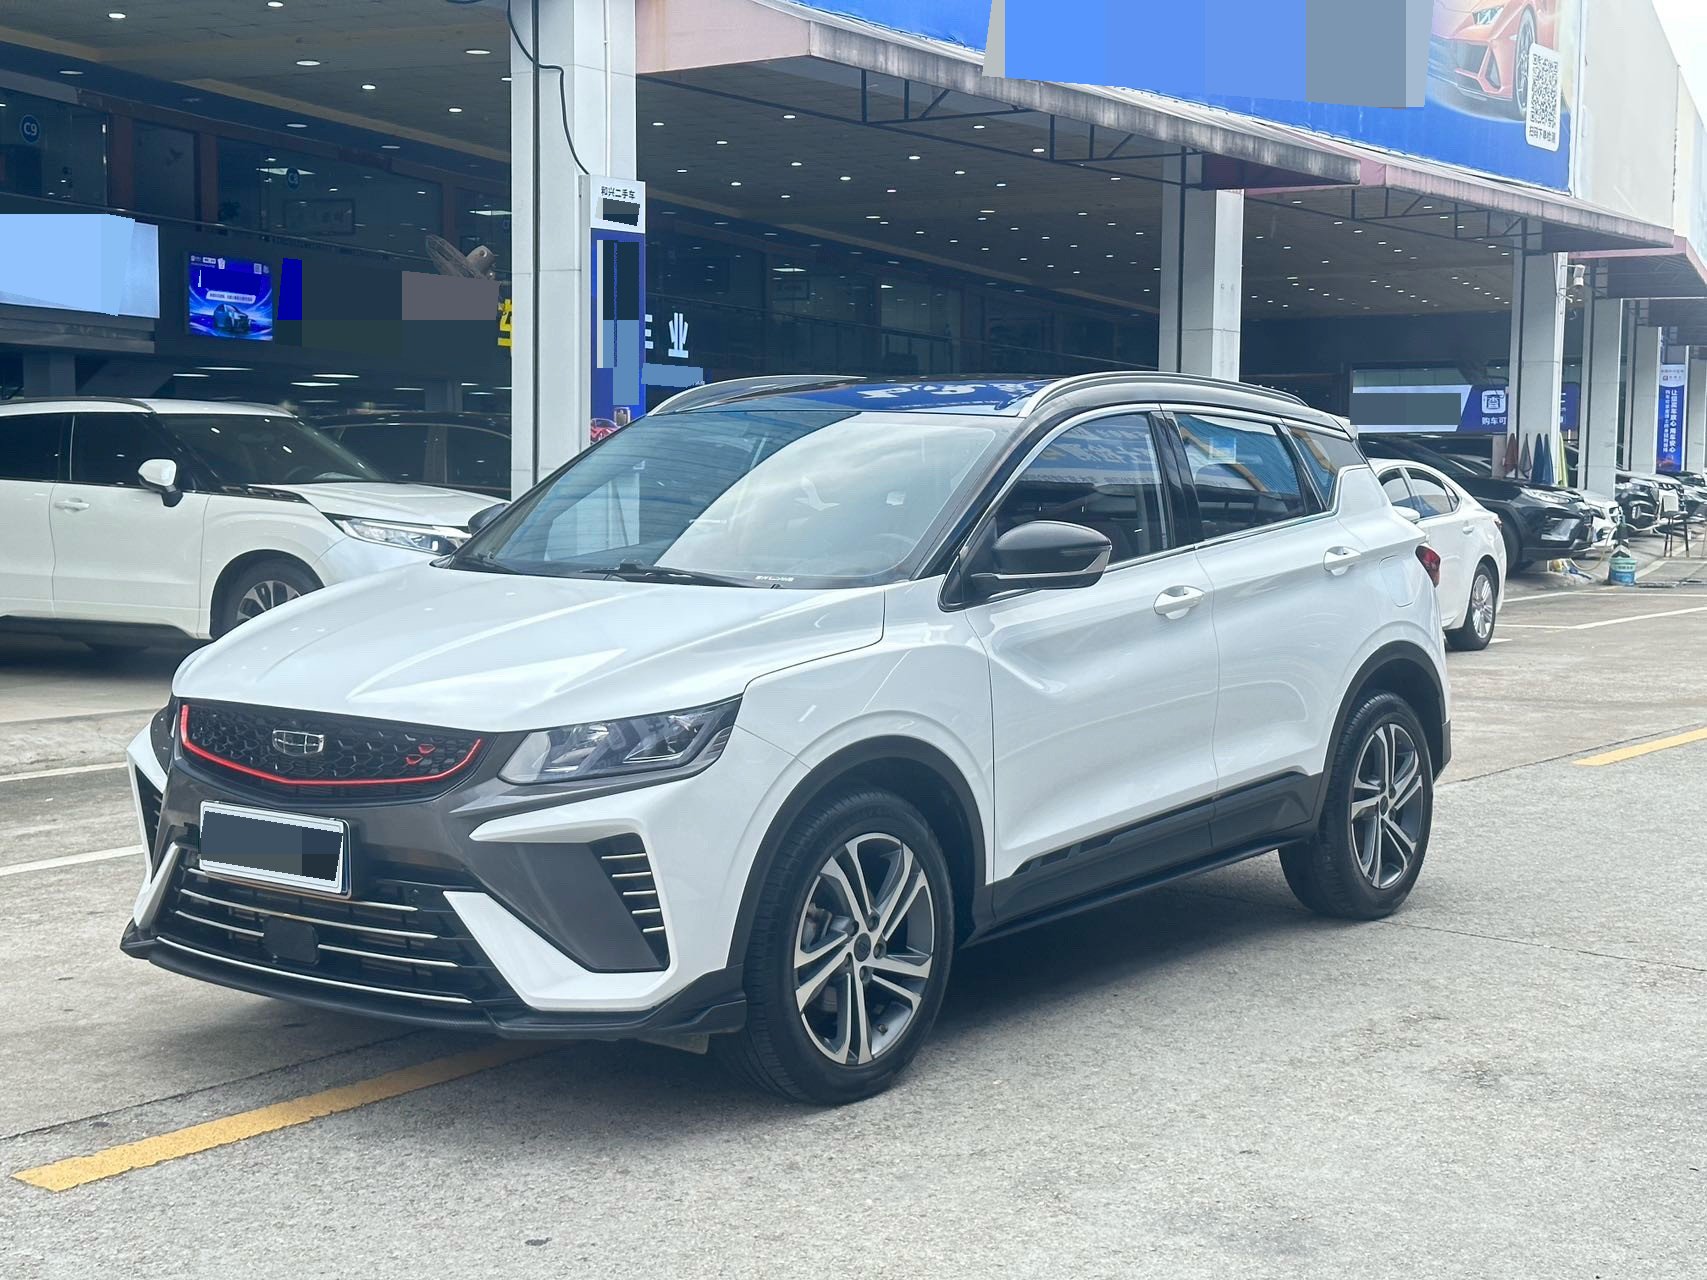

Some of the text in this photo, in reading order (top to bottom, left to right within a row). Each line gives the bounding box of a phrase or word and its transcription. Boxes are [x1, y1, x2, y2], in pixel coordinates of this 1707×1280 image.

[23, 122, 38, 136] C9
[600, 186, 636, 200] 和兴二手车
